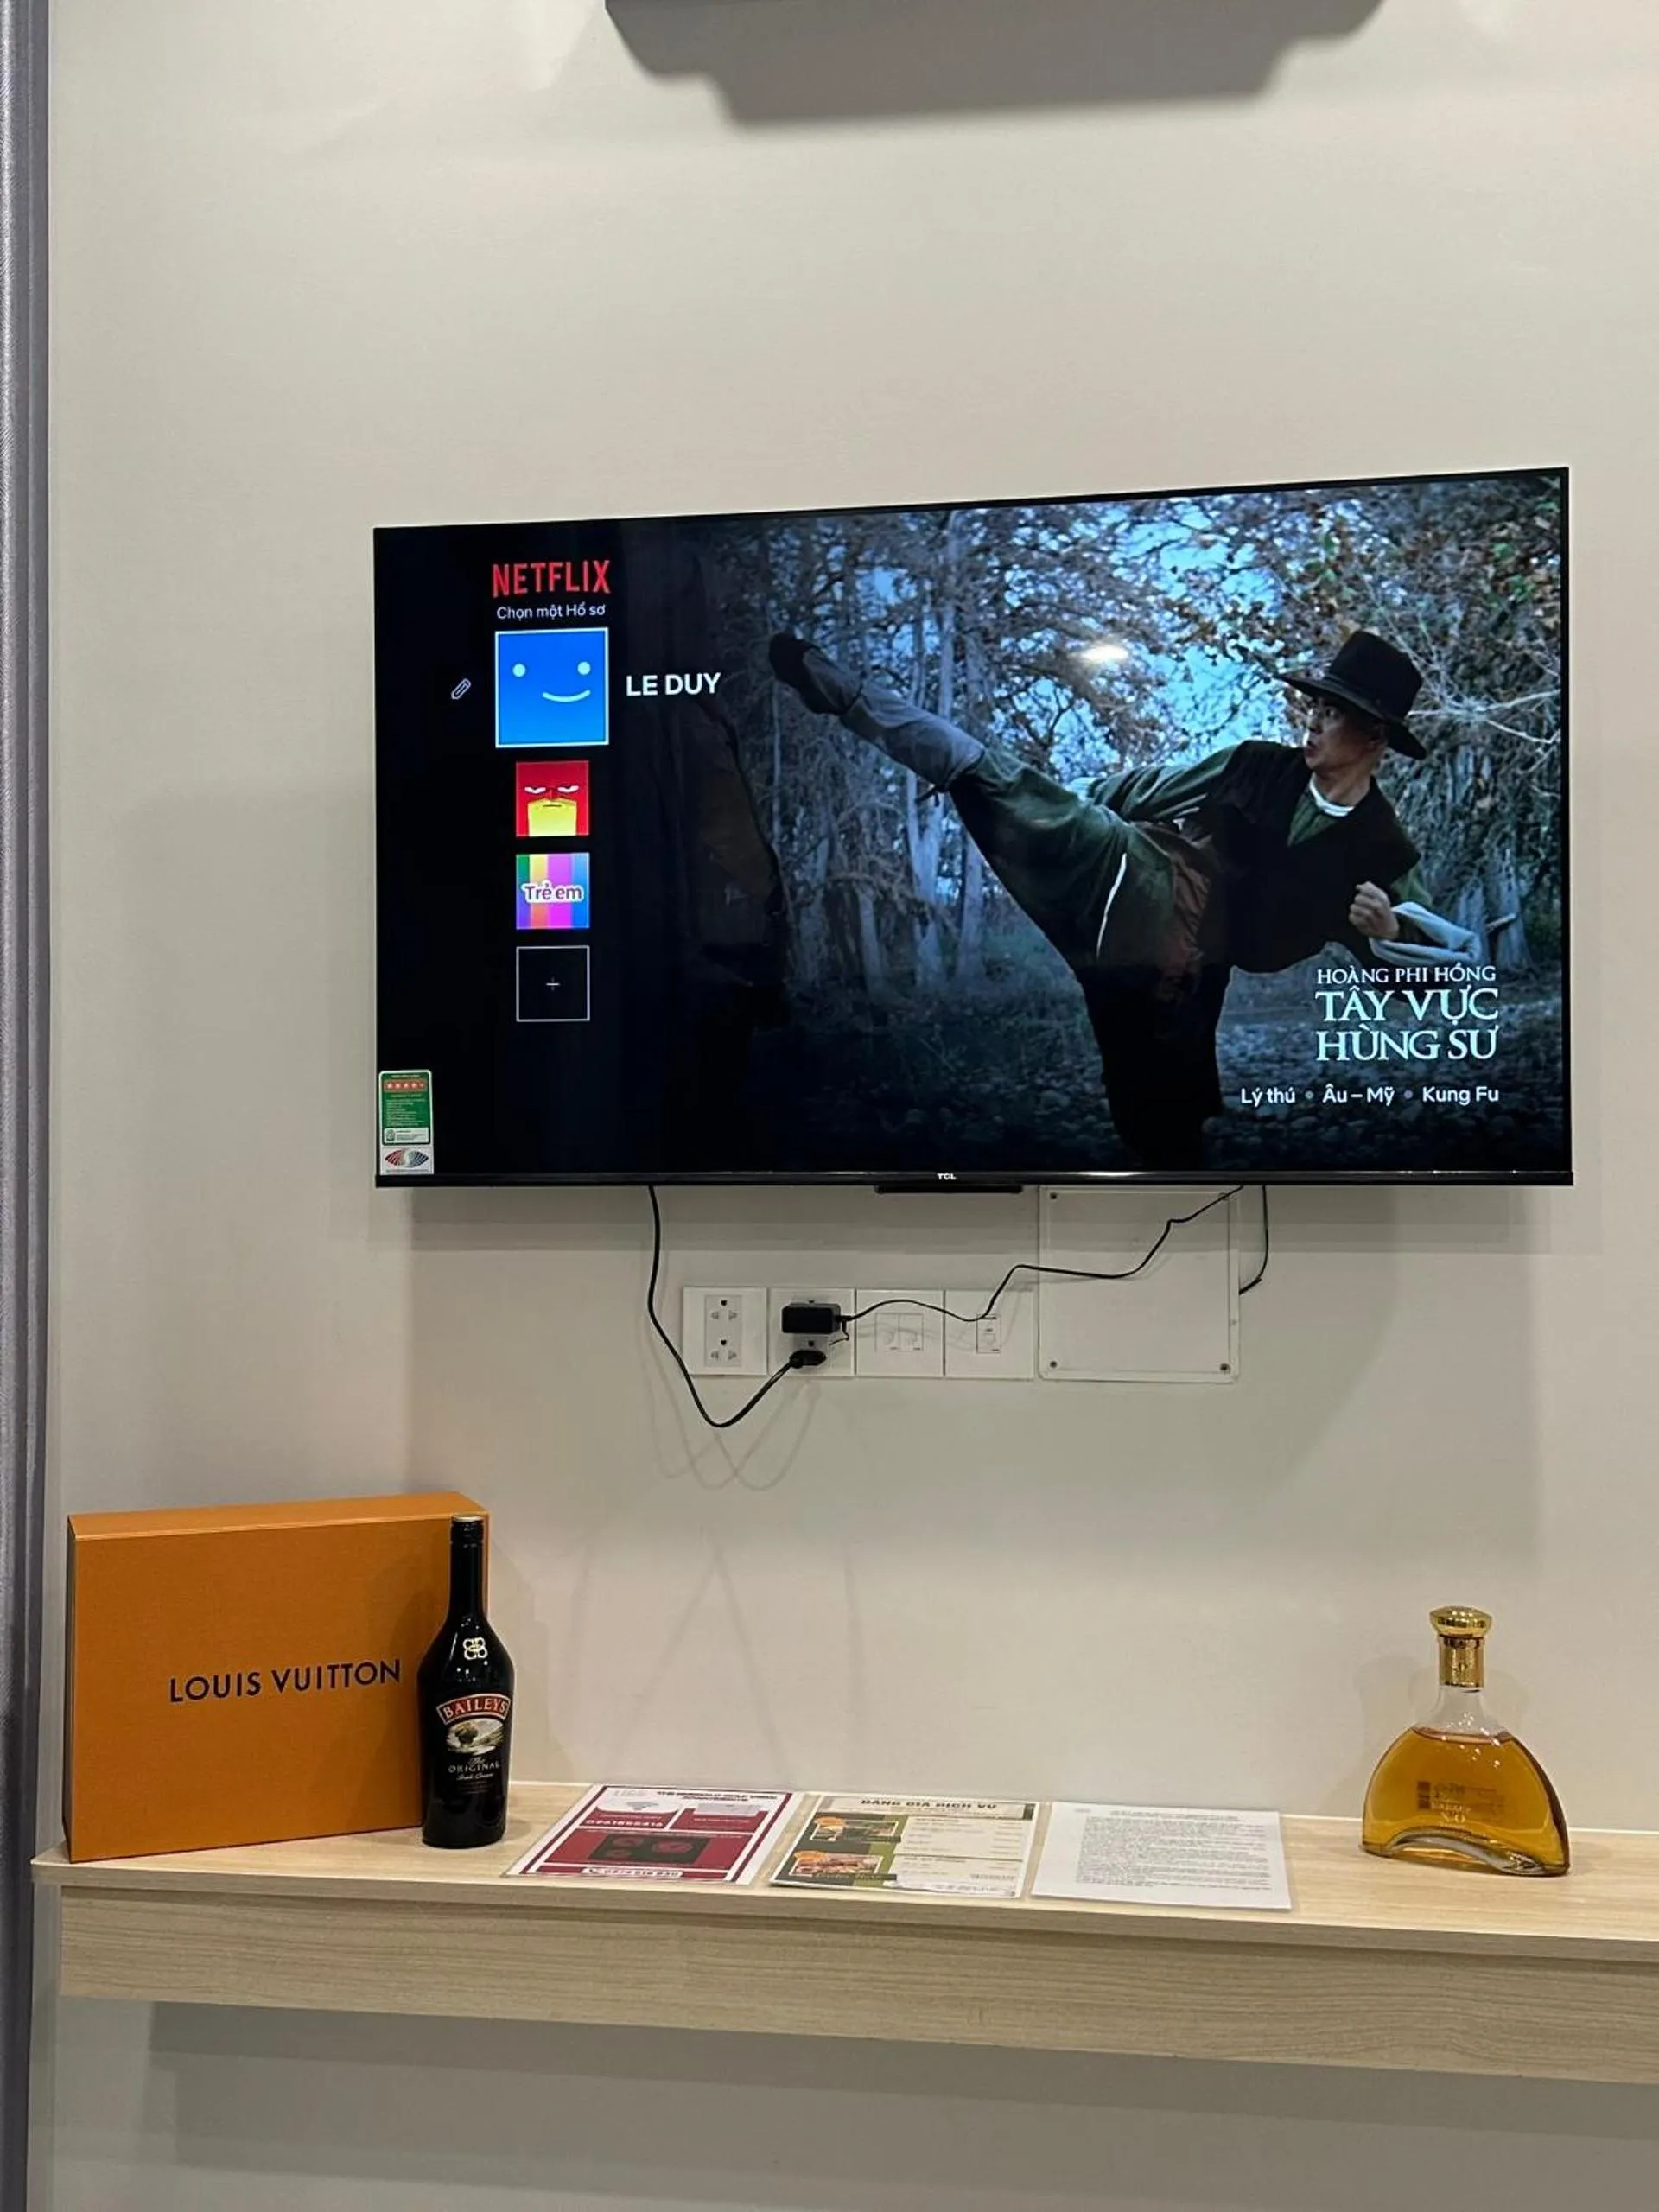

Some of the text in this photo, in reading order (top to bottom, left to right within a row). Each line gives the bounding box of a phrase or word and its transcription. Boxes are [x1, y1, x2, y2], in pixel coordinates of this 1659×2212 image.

[492, 560, 610, 598] NETFLIX
[496, 606, 533, 621] Chọn
[536, 604, 563, 620] một
[626, 672, 721, 696] LE DUY
[524, 882, 582, 900] Trẻ em
[1317, 964, 1389, 984] HOÀNG
[1395, 967, 1427, 982] PHI
[1314, 984, 1499, 1025] TÂY VỰC
[1317, 1023, 1500, 1061] HÙNG SƯ
[1241, 1088, 1262, 1107] Lý
[1266, 1087, 1296, 1103] thú
[1322, 1084, 1348, 1103] Âu
[1366, 1086, 1395, 1106] Mỹ
[1422, 1087, 1470, 1105] Kung
[1475, 1086, 1499, 1103] Fu
[937, 1172, 957, 1180] TCL
[170, 1659, 401, 1702] LOUIS VUITTON
[442, 1698, 508, 1719] BAILEYS
[448, 1762, 501, 1774] ORIGINAL
